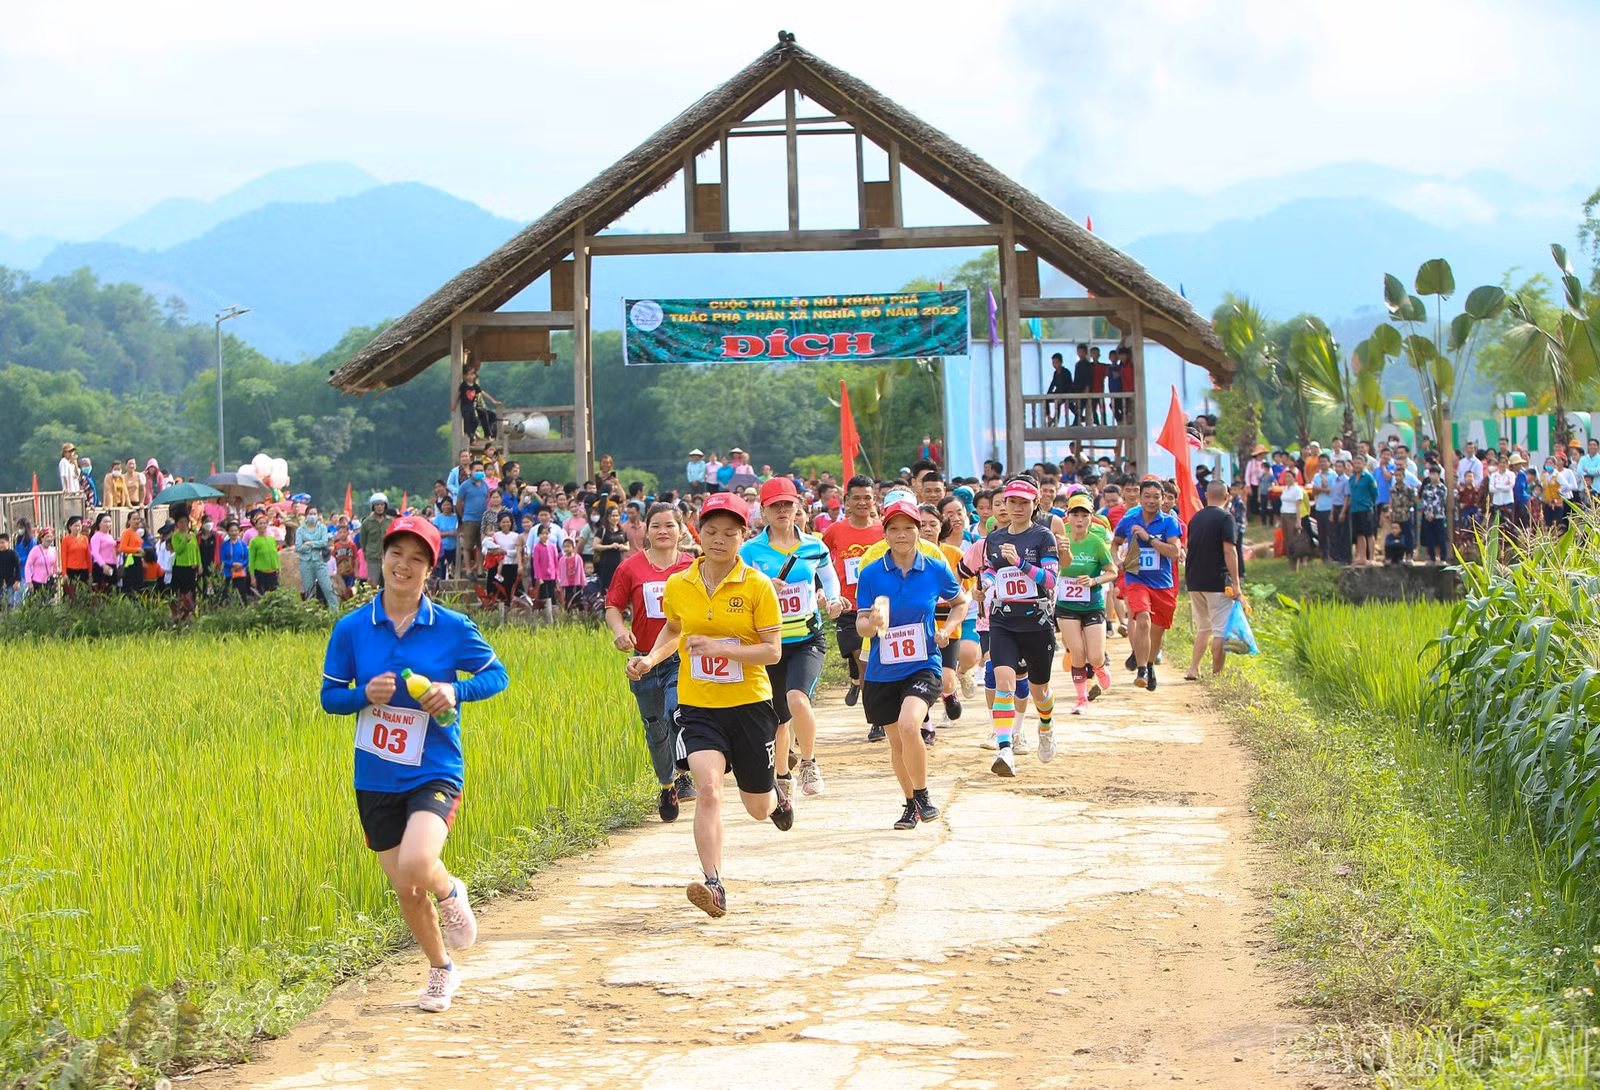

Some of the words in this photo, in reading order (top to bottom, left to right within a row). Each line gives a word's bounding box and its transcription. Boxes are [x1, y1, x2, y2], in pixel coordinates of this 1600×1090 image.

[709, 298, 748, 310] CUỘC
[752, 299, 776, 308] THI
[813, 296, 838, 306] NÚI
[842, 295, 885, 305] KHÁM
[889, 293, 919, 304] PHÁ
[668, 310, 708, 322] THÁC
[813, 307, 856, 318] NGHĨA
[886, 306, 918, 316] NĂM
[921, 306, 959, 316] 2023
[720, 327, 875, 358] ĐÍCH
[1139, 556, 1153, 567] 10
[1006, 579, 1028, 596] 06
[1065, 586, 1084, 598] 22
[779, 596, 801, 614] 09
[889, 639, 916, 658] 18
[701, 655, 729, 676] 02
[372, 723, 408, 754] 03
